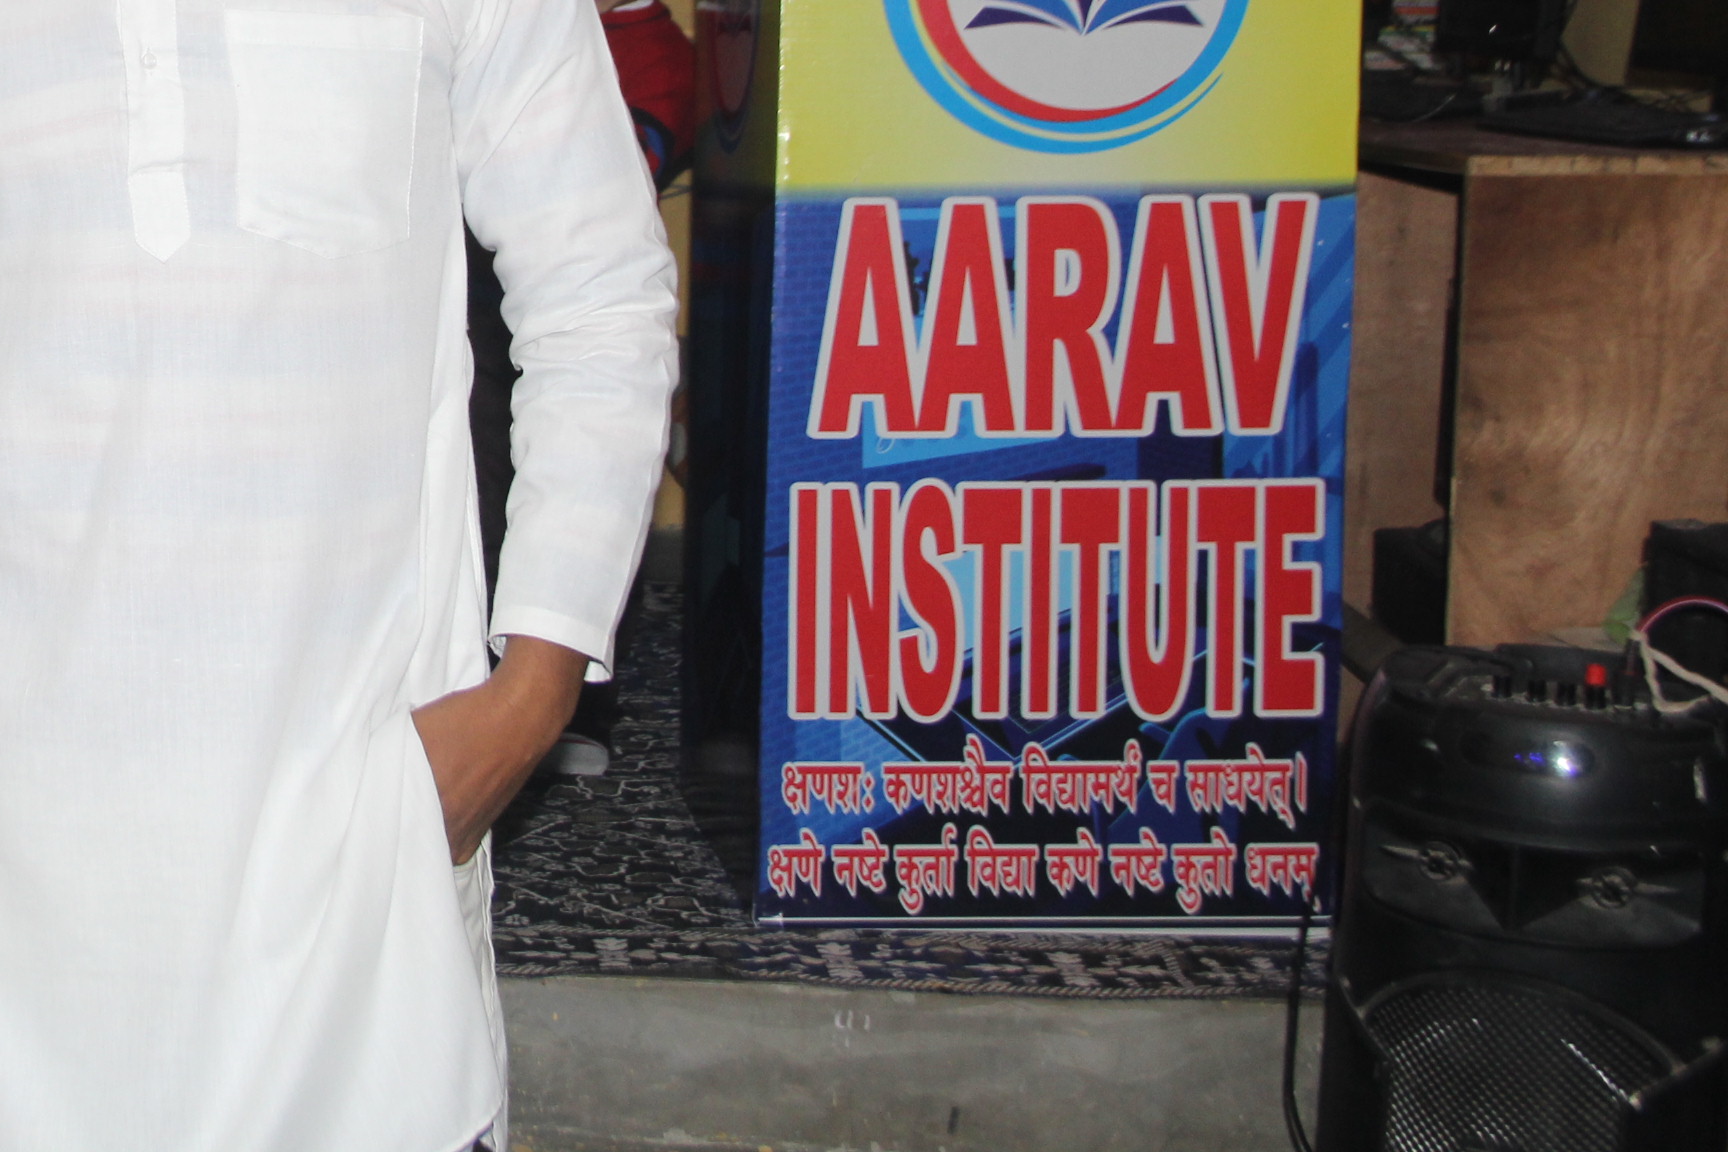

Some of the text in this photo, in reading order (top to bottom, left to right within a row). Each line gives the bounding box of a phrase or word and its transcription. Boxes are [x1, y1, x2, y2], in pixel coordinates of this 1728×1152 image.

[806, 193, 1320, 440] AARAV
[788, 478, 1326, 723] INSTITUTE
[768, 827, 825, 898] क्षणे
[965, 824, 1039, 898] विद्या
[1044, 826, 1103, 897] कणे
[1147, 759, 1179, 814] च
